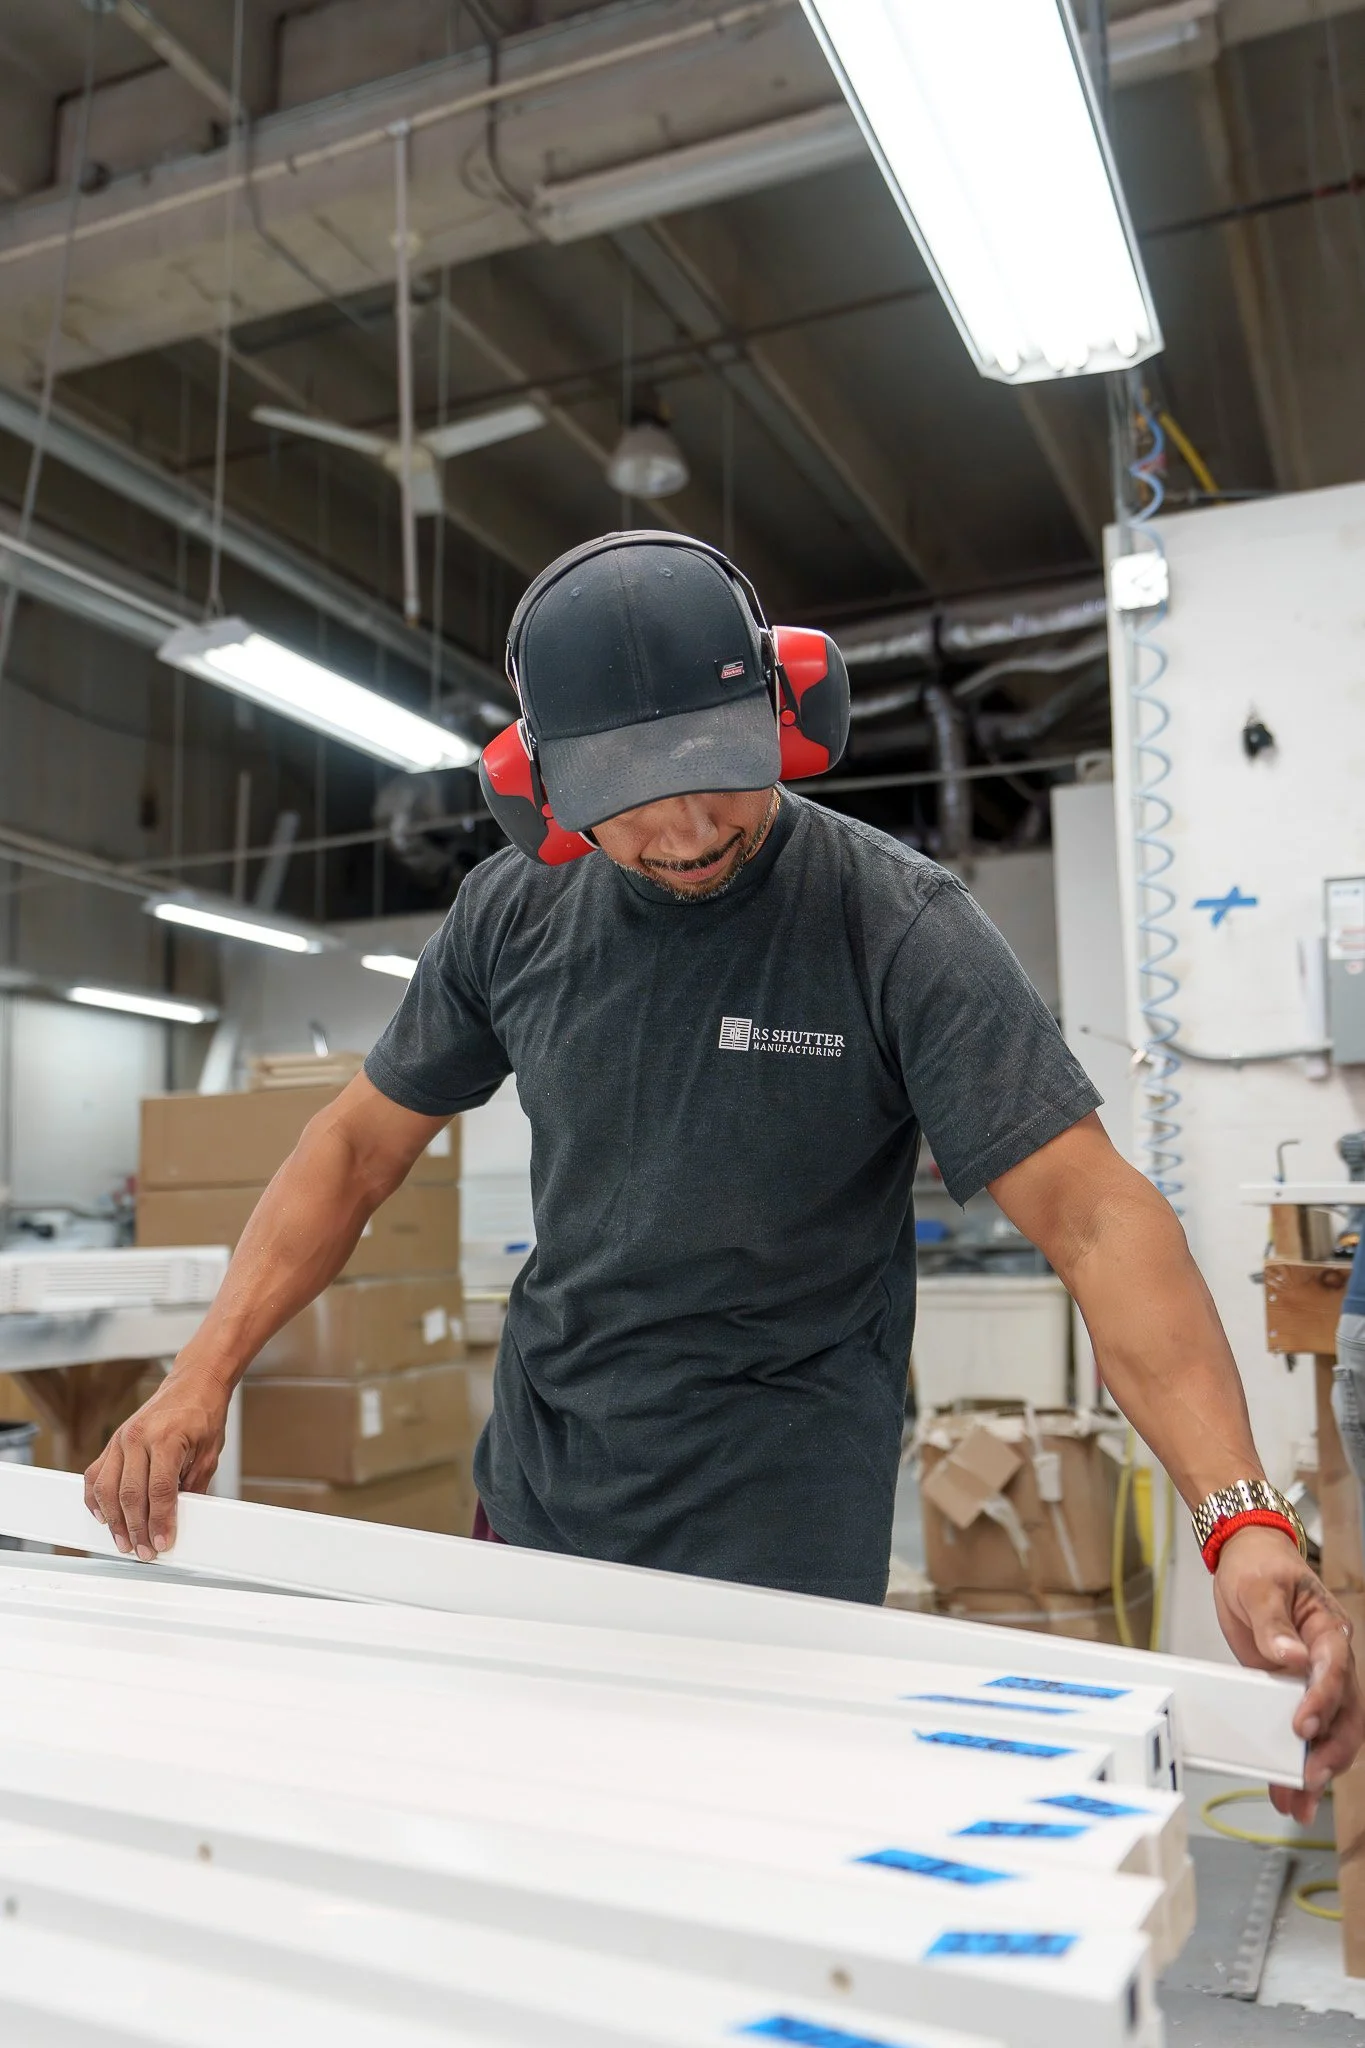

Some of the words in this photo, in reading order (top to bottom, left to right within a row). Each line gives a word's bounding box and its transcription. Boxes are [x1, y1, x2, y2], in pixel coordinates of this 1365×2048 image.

[752, 1027, 769, 1041] RS
[771, 1029, 846, 1048] SHUTTER
[753, 1041, 842, 1058] MANUFACTURING
